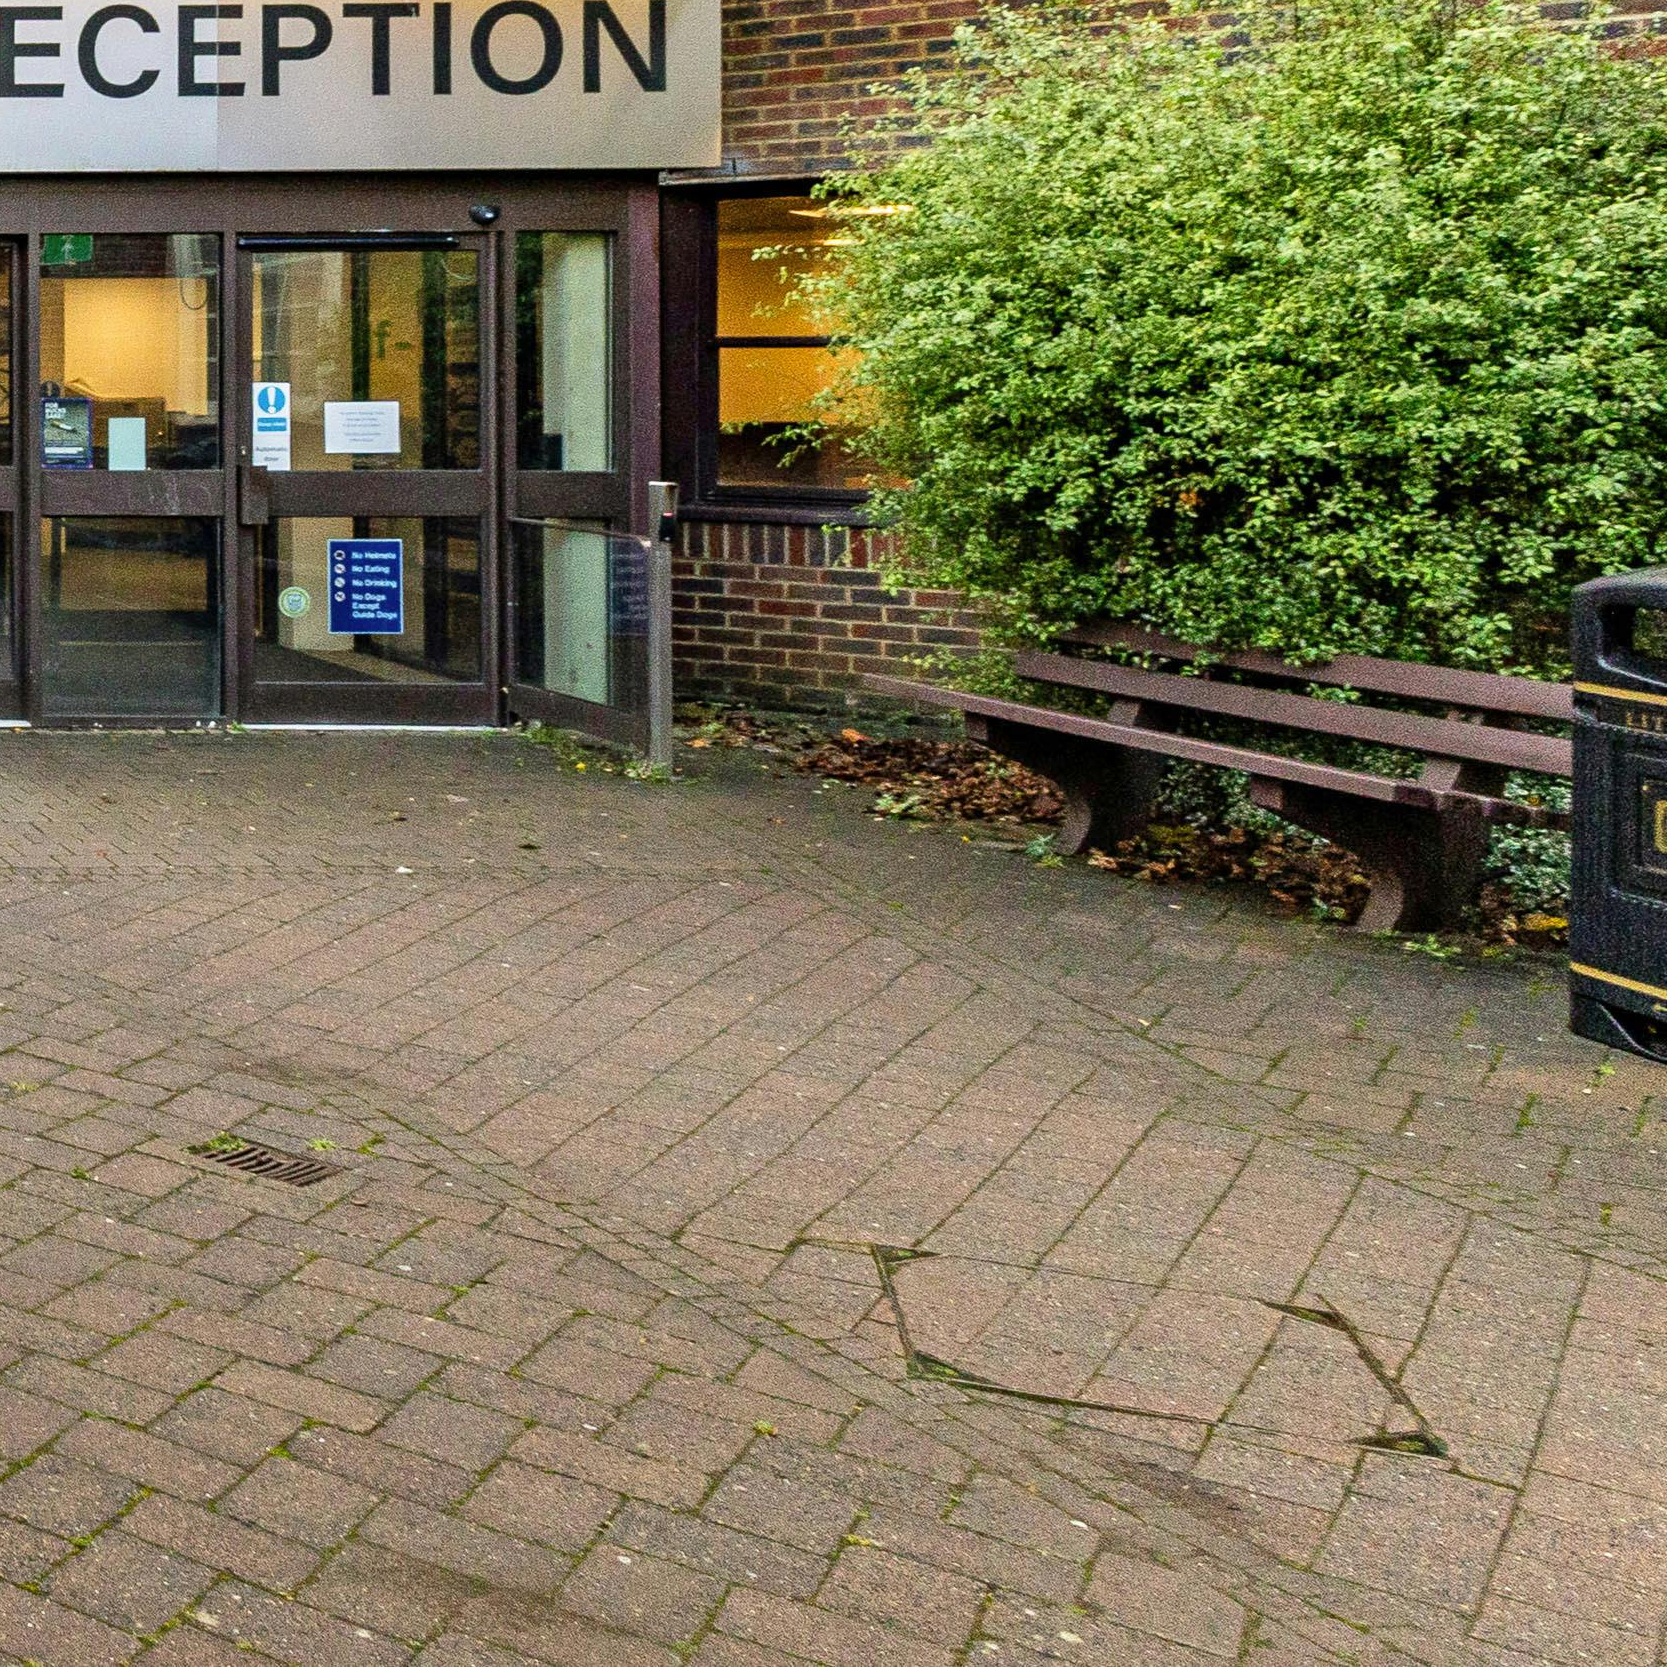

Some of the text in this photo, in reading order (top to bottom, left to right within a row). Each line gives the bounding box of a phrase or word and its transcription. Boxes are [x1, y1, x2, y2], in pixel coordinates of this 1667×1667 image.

[365, 551, 396, 559] Helmets
[365, 565, 390, 574] Eating
[364, 579, 397, 588] Drinking
[364, 593, 386, 601] Dogs
[352, 602, 380, 610] Except
[376, 611, 397, 619] Dogs
